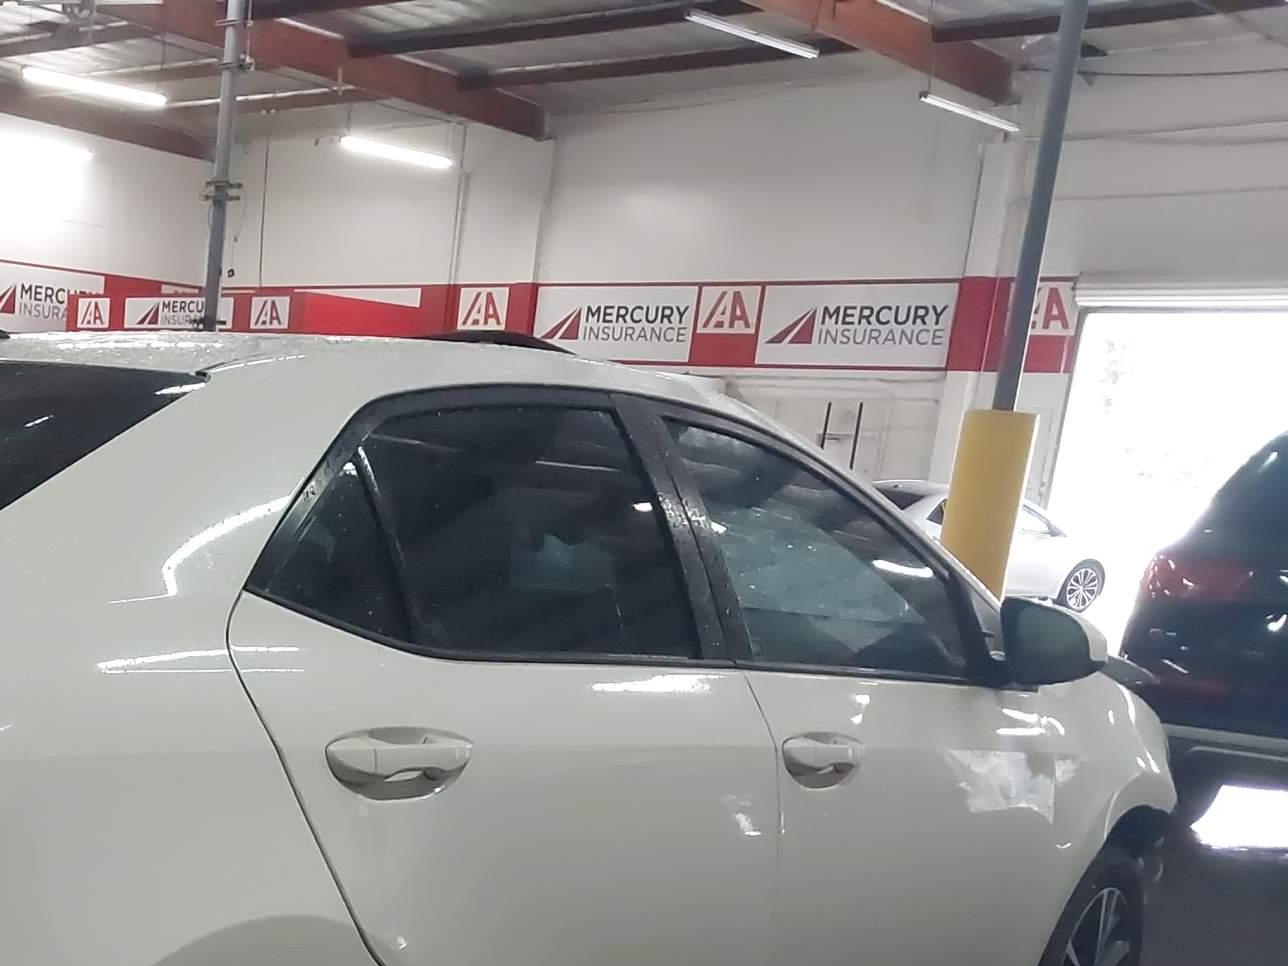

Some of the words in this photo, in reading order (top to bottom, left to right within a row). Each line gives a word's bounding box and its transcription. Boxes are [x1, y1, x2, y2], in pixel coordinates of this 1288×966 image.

[18, 302, 68, 321] INSUR
[161, 300, 205, 313] MERCU
[585, 304, 690, 324] MERCURY
[819, 304, 950, 326] MERCURY
[582, 326, 688, 343] INSURANCE
[817, 327, 946, 346] INSURANCE
